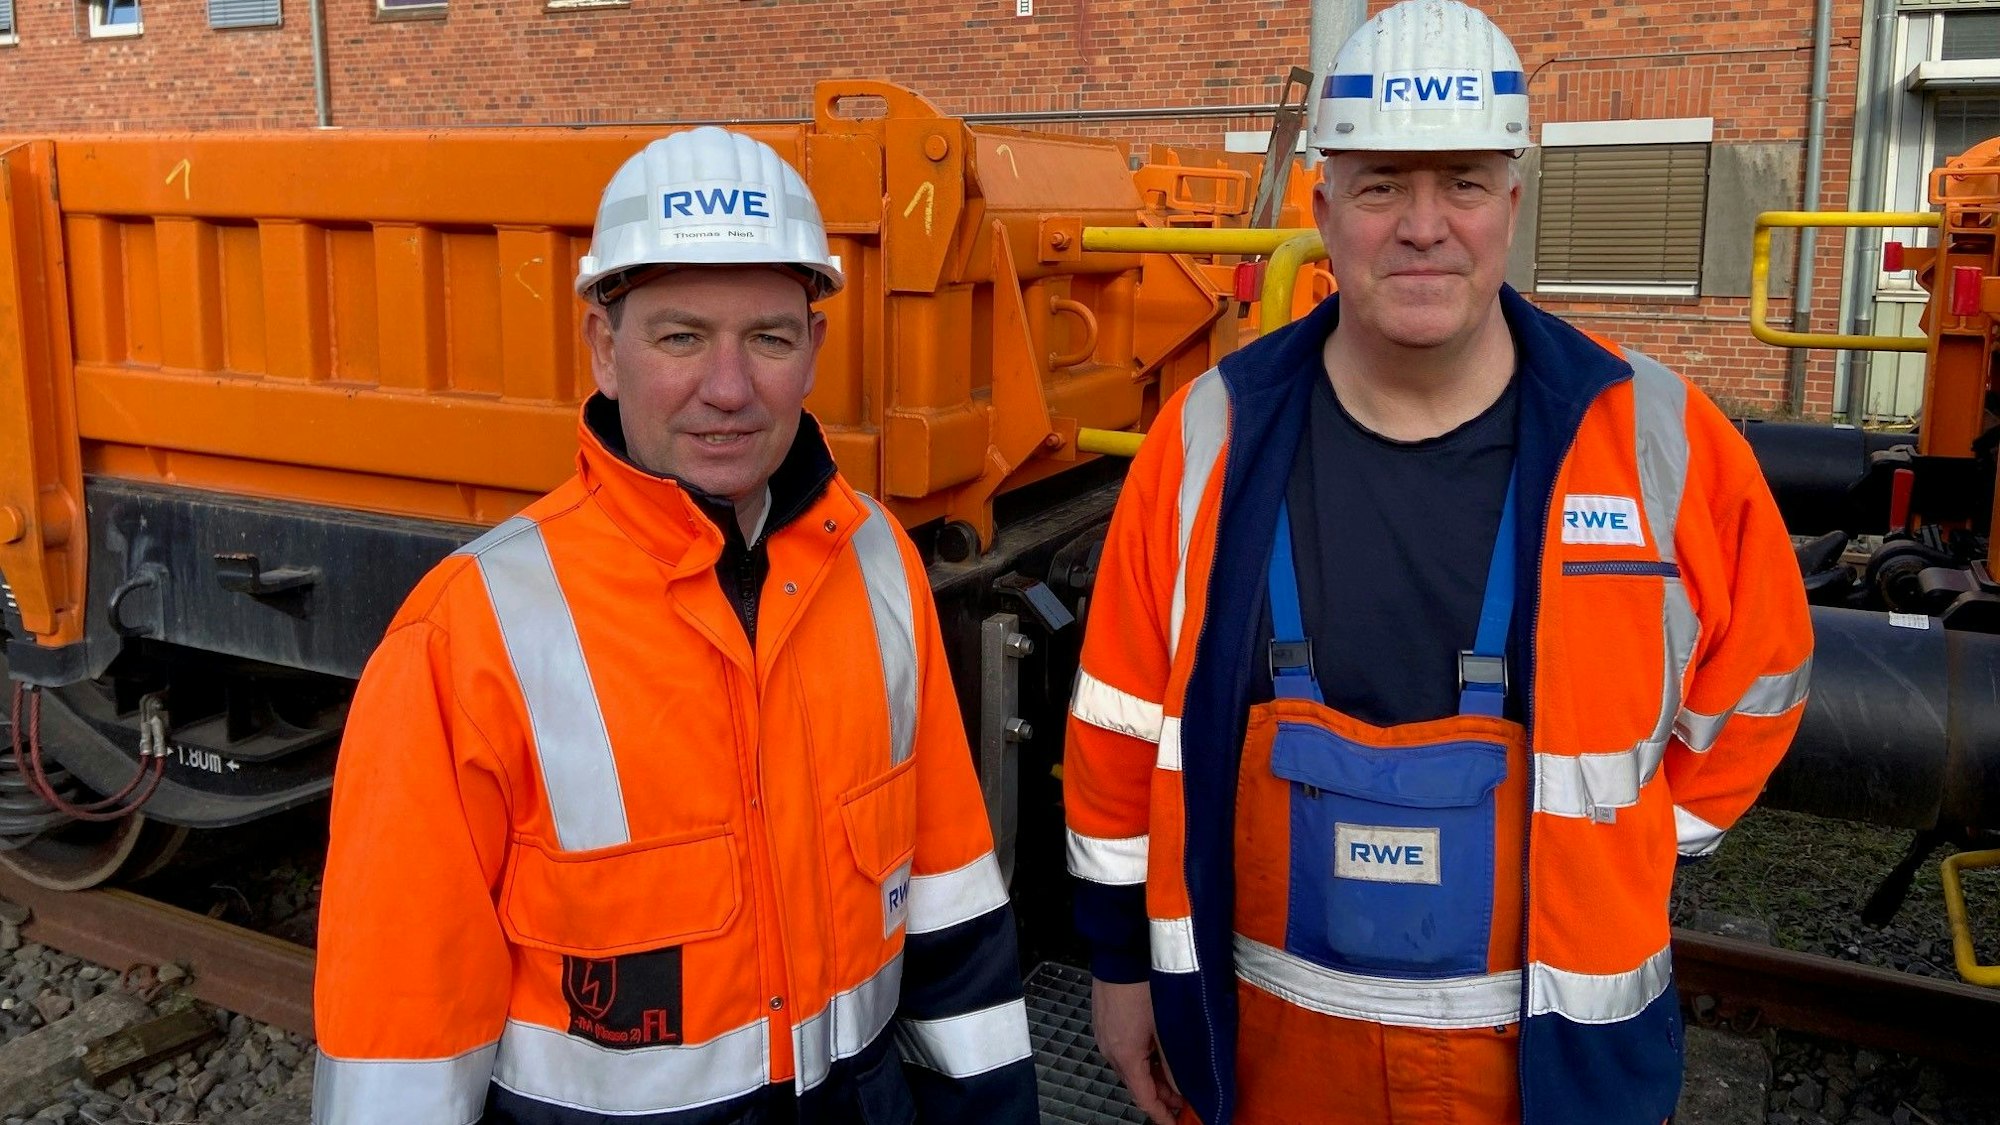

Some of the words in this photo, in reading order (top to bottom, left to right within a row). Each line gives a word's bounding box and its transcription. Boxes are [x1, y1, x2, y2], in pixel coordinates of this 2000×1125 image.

[1384, 75, 1480, 103] RWE
[663, 188, 770, 219] RWE
[673, 231, 721, 239] Thomas
[1562, 510, 1628, 530] RWE
[1350, 842, 1425, 865] RWE
[889, 876, 911, 913] RW
